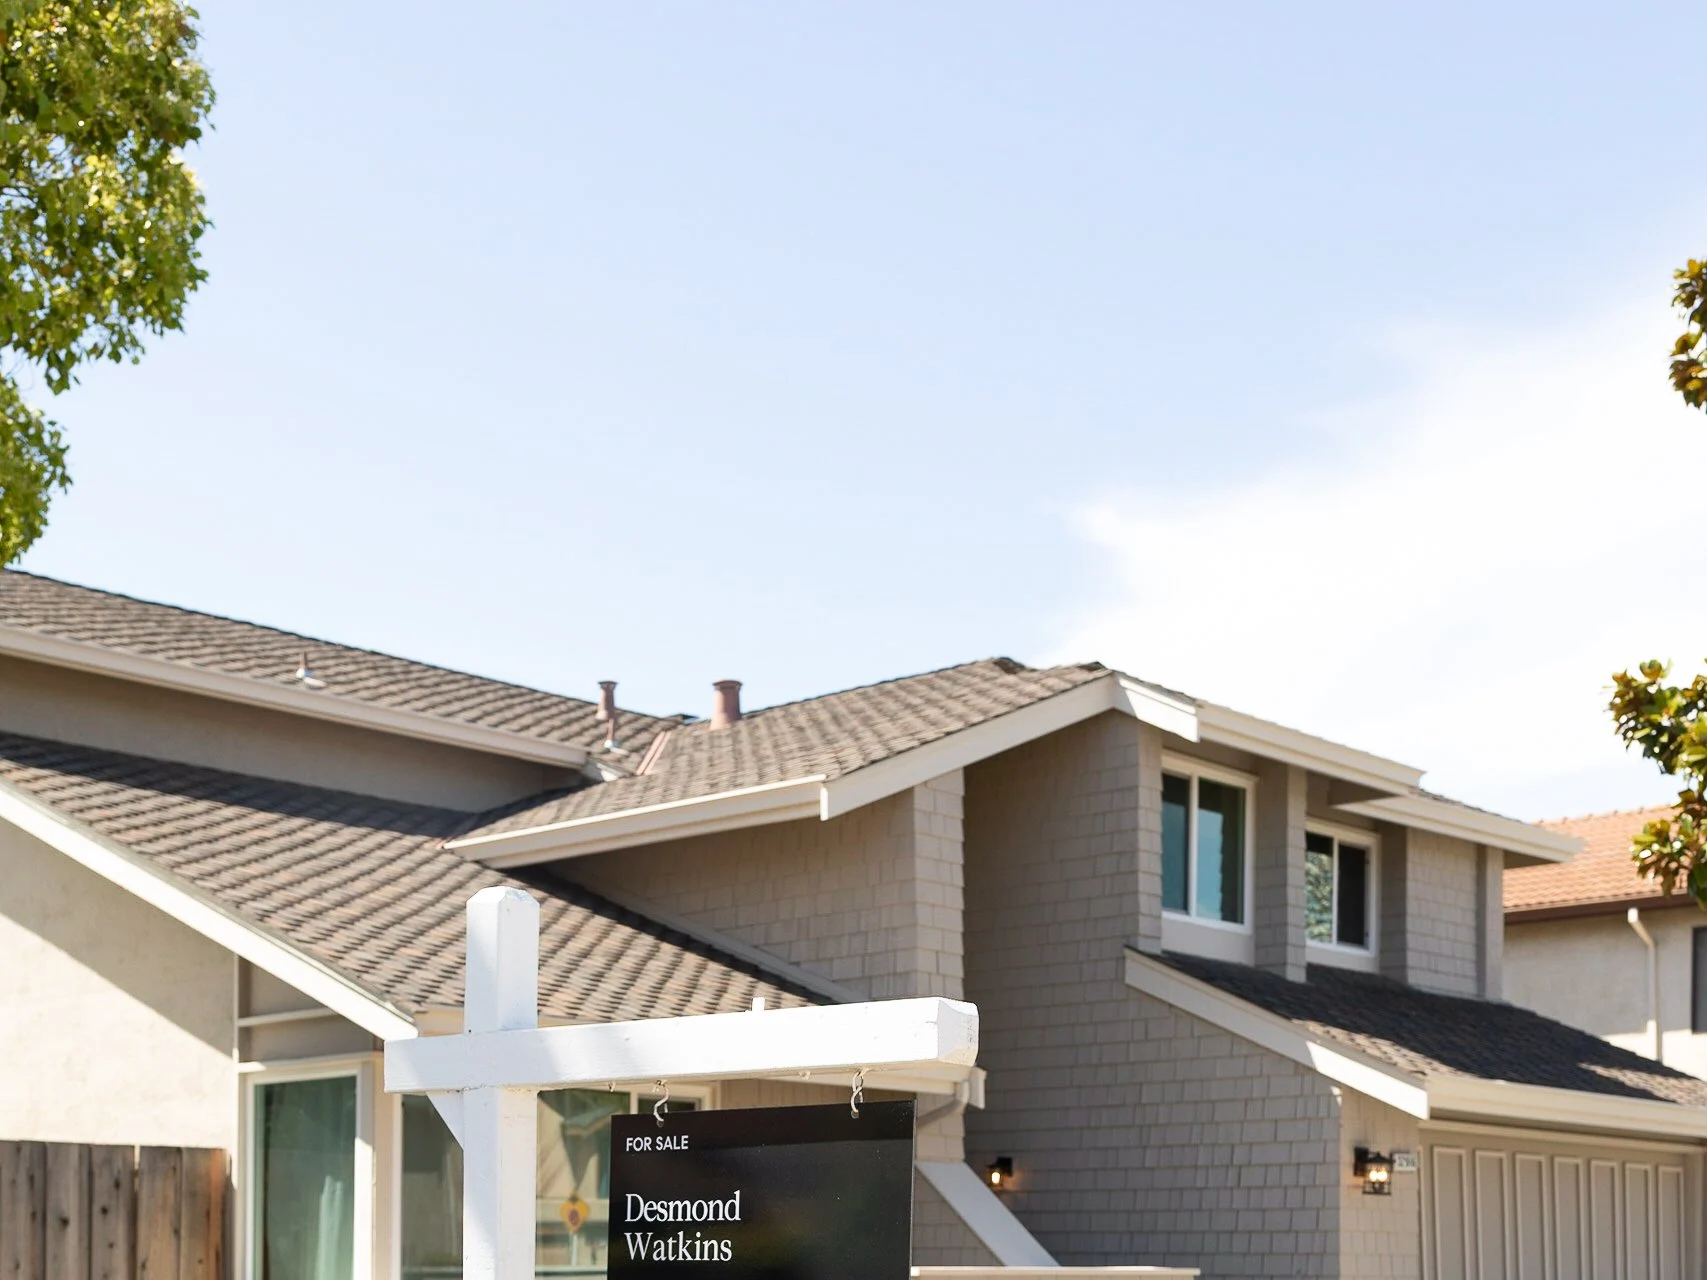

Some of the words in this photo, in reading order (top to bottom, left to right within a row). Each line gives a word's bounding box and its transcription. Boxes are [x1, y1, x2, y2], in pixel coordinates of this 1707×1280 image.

[625, 1136, 653, 1152] FOR
[655, 1134, 689, 1151] SALE
[624, 1189, 742, 1223] Desmond
[623, 1230, 733, 1262] Watkins
